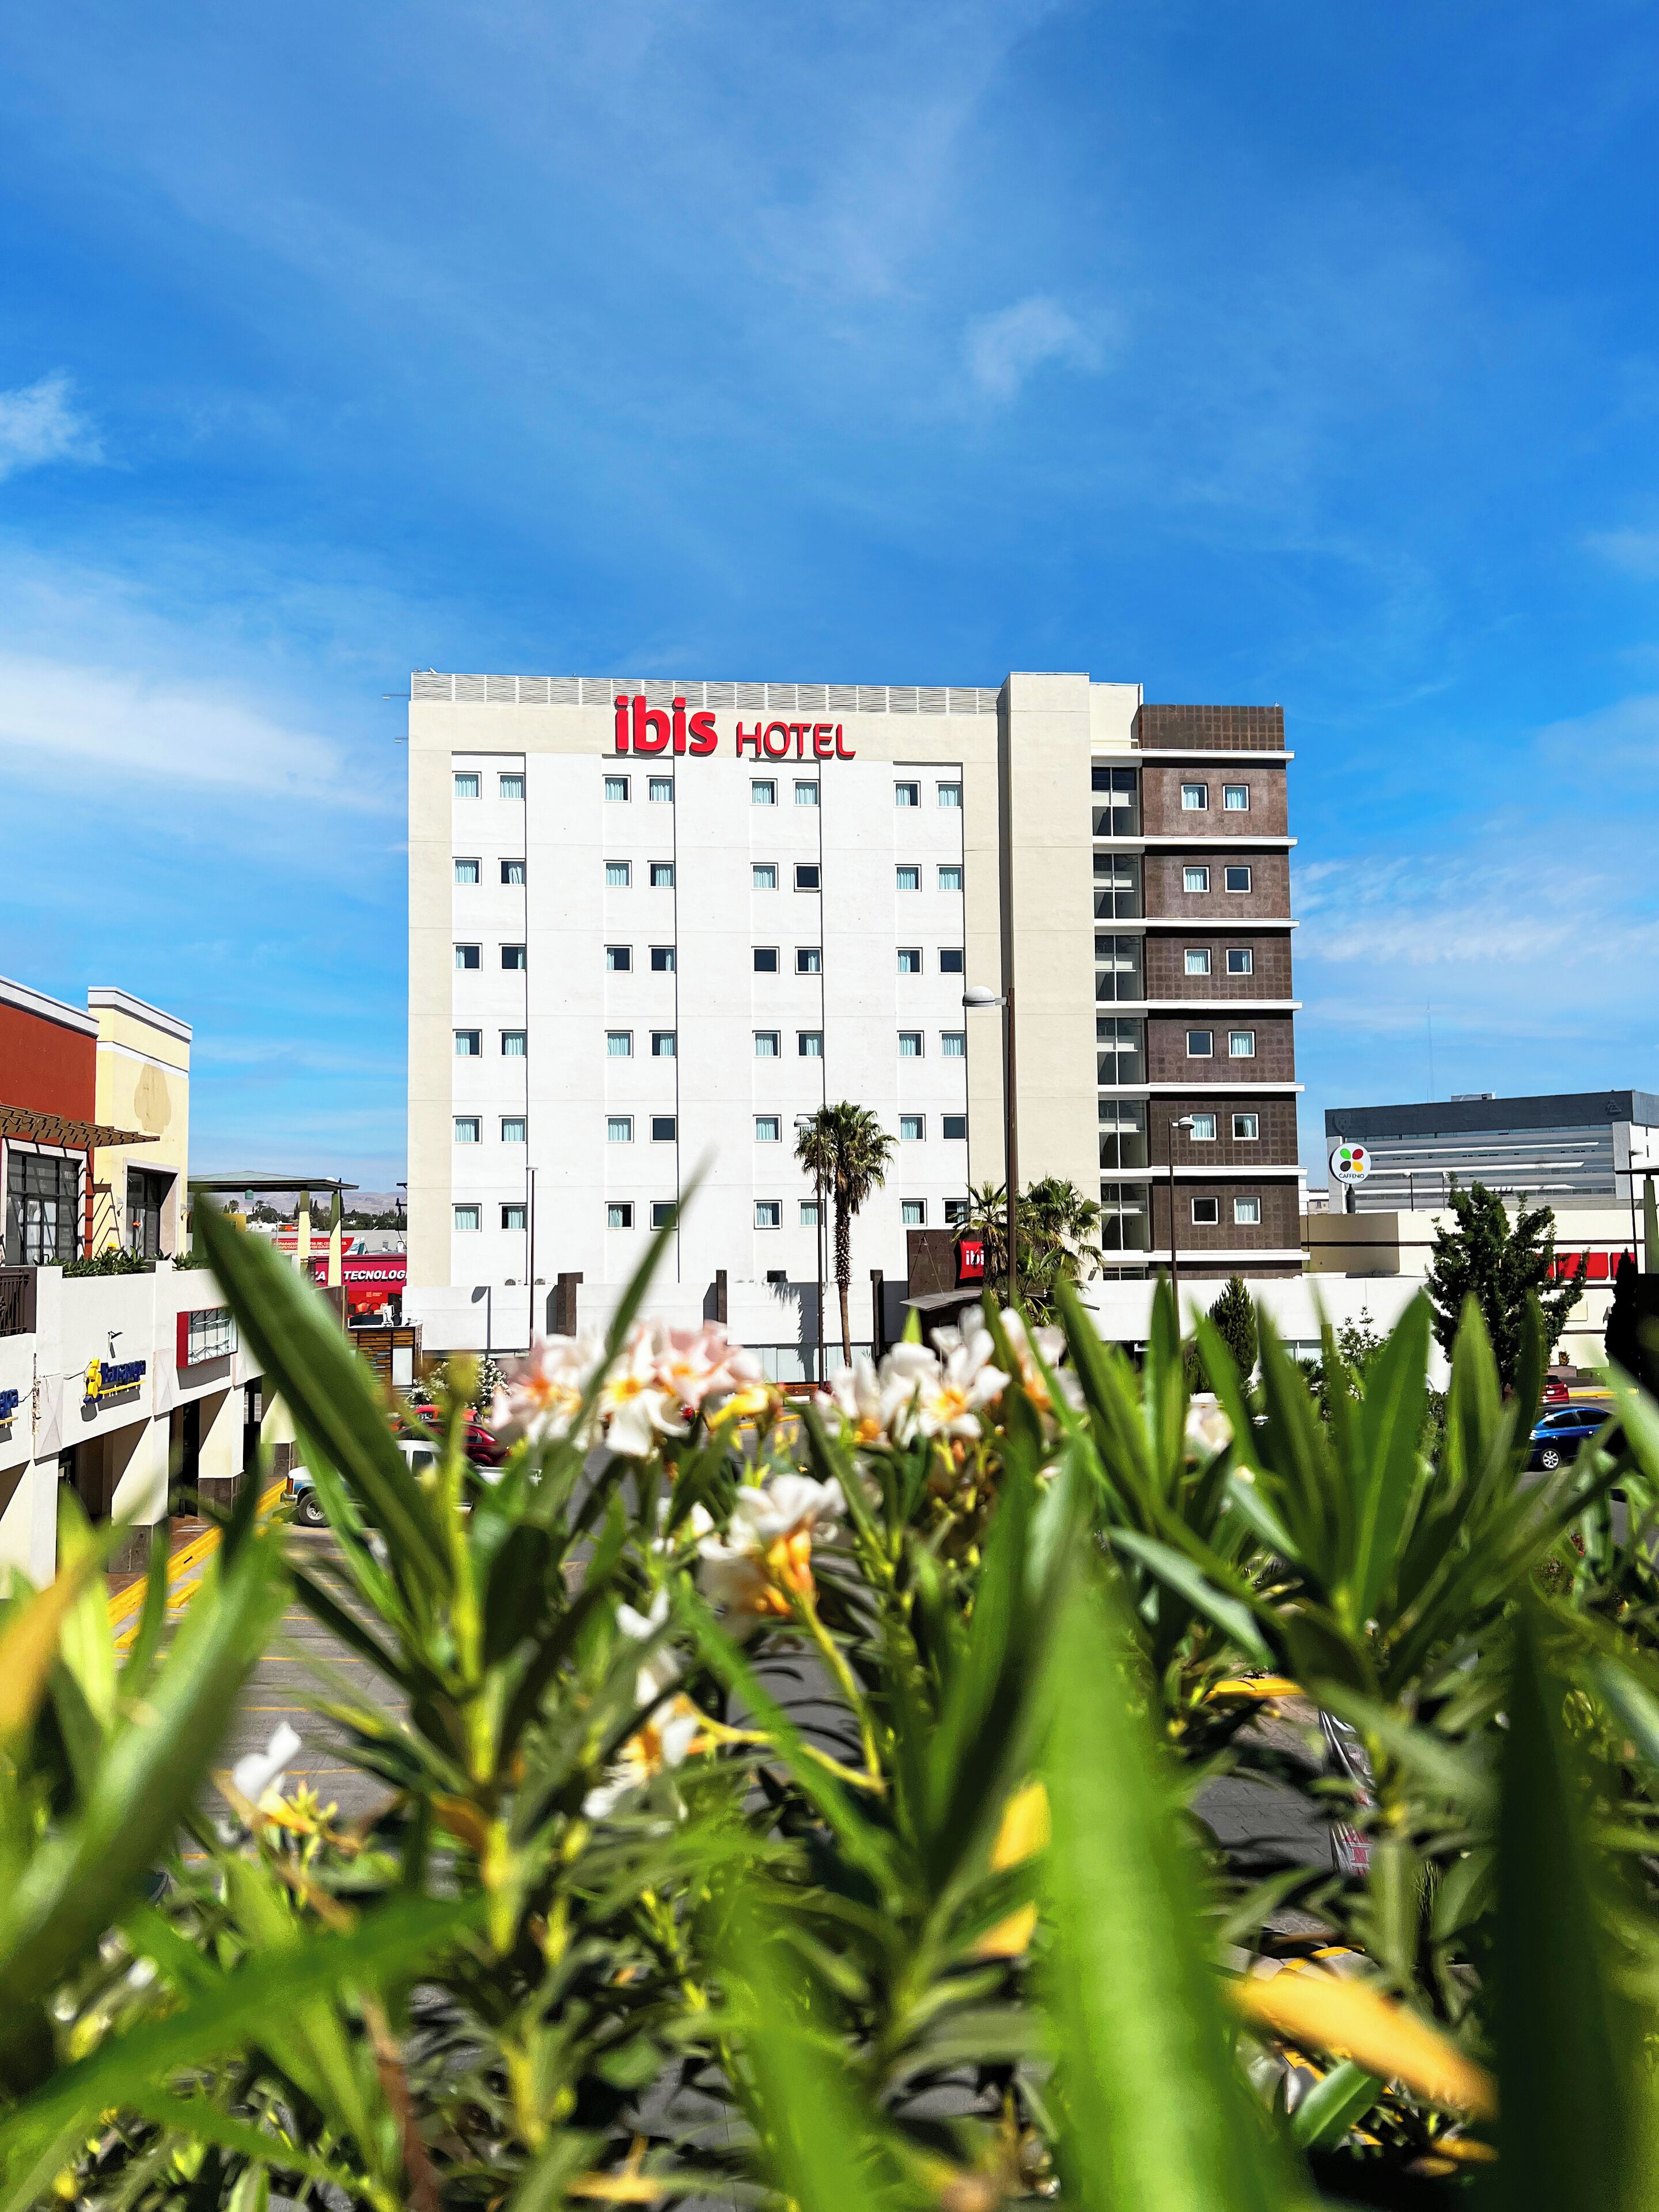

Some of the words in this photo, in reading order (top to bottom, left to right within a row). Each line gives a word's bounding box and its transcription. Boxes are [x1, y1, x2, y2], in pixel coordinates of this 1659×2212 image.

[615, 695, 718, 753] ibis
[737, 721, 857, 758] HOTEL
[965, 1250, 984, 1266] ibi
[343, 1270, 407, 1281] TECNOLOG
